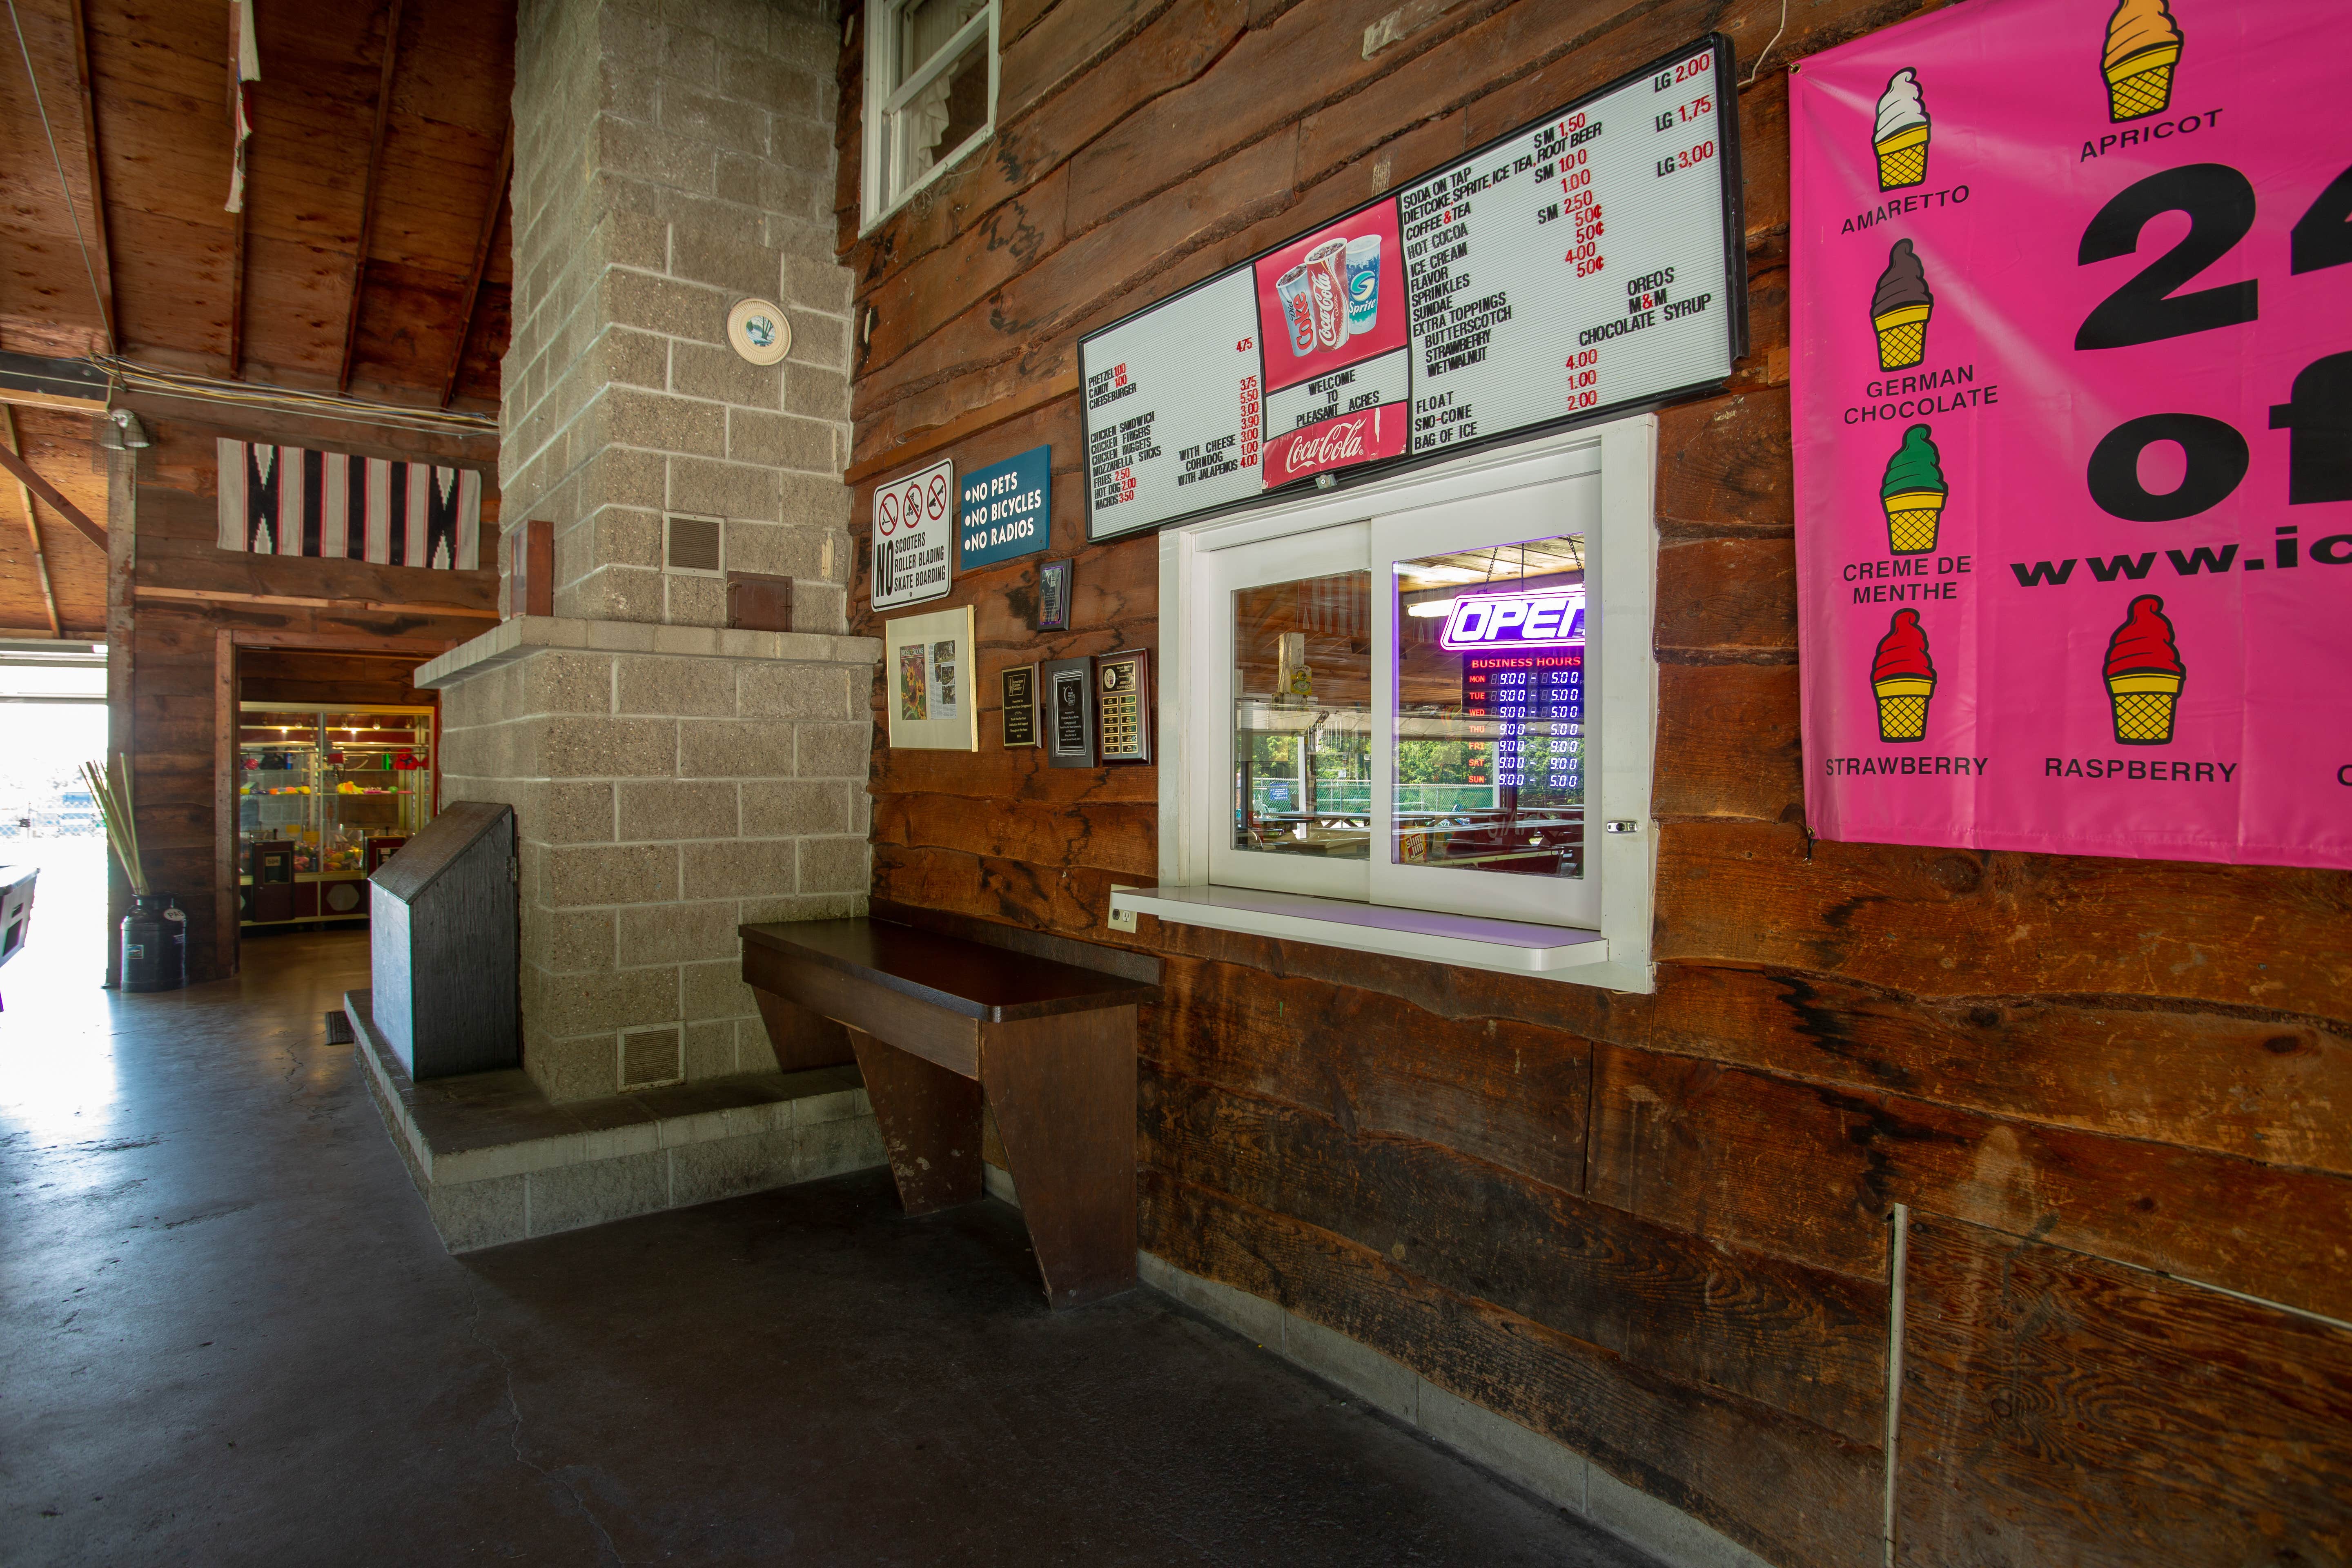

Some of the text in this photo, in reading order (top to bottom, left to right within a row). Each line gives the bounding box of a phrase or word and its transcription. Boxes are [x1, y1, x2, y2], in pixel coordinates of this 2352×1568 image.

[1403, 187, 1431, 209] SODA
[1432, 178, 1447, 196] ON
[1450, 167, 1471, 188] TAP
[1534, 127, 1555, 149] SM
[1655, 72, 1671, 94] LG
[1676, 54, 1710, 83] 2.00
[1492, 165, 1510, 185] ICE
[1537, 137, 1567, 163] ROOT
[1570, 121, 1602, 148] BEER
[2080, 109, 2224, 163] APRICOT
[1406, 214, 1442, 241] COFFEE
[1443, 210, 1452, 224] &
[1452, 201, 1471, 220] TEA
[1535, 163, 1554, 183] SM
[1656, 111, 1673, 133] LG
[1410, 259, 1426, 278] ICE
[1430, 241, 1468, 269] CREAM
[1537, 203, 1558, 224] SM
[1657, 157, 1675, 177] LG
[1840, 184, 1970, 236] AMARETTO
[1407, 238, 1428, 260] HOT
[1432, 222, 1468, 249] COCOA
[1411, 204, 1602, 293] FLAVOR 50¢
[1412, 221, 1604, 307] SPRINKLES 50¢
[1287, 300, 1296, 321] Diet
[1349, 299, 1376, 316] Sprite
[1413, 256, 1604, 337] EXTRA TOPPINGS 50¢
[1413, 295, 1452, 321] SUNDAE
[1425, 267, 1674, 348] BUTTERSCOTCH OREOS
[1579, 310, 1655, 346] CHOCOLATE
[1664, 293, 1711, 321] SYRUP
[1426, 329, 1491, 363] STRAWBERRY
[1089, 337, 1252, 410] CHEESEBURGER 4.75
[1089, 368, 1114, 388] PRETZEL
[1089, 382, 1109, 399] CANDY
[1308, 369, 1356, 396] WELCOME
[1326, 389, 1338, 403] TO
[1417, 349, 1597, 414] FLOAT 4.00
[1866, 364, 1974, 399] GERMAN
[1090, 375, 1257, 443] CHICKEN SANDWICH 3.75
[1091, 388, 1258, 455] CHICKEN FINGERS 5.50
[1296, 390, 1379, 427] PLEASANT ACRES
[1415, 370, 1597, 431] SNO-CONE 1.00
[1415, 390, 1597, 450] BAG OF ICE 2.00
[1843, 385, 1999, 425] CHOCOLATE
[1092, 401, 1258, 466] CHICKEN NUGGETS 3.00
[1093, 414, 1259, 477] MOZZARELLA STICKS 3.90
[1094, 428, 1258, 488] FRIES 2.50 WITH CHEESE 3.00
[1095, 441, 1258, 499] HOT DOG 2.00 CORNDOG 1.00
[971, 471, 1018, 503] NO PETS
[1095, 494, 1118, 510] NACHOS
[1178, 472, 1196, 486] WITH
[1198, 459, 1238, 481] JALAPENOS
[1241, 453, 1258, 468] 4.00
[971, 489, 1042, 528] NO BICYCLES
[895, 532, 926, 554] SCOOTERS
[971, 517, 1034, 552] NO RADIOS
[876, 540, 894, 598] NO
[894, 566, 946, 592] SKATE BOARDING
[895, 545, 944, 573] ROLLER BLADING
[1842, 555, 1971, 582] CREME DE
[1851, 582, 1958, 605] MENTHE
[1472, 656, 1581, 668] BUSINESS HOURS
[1825, 757, 1989, 777] STRAWBERRY
[2045, 758, 2238, 783] RASPBERRY
